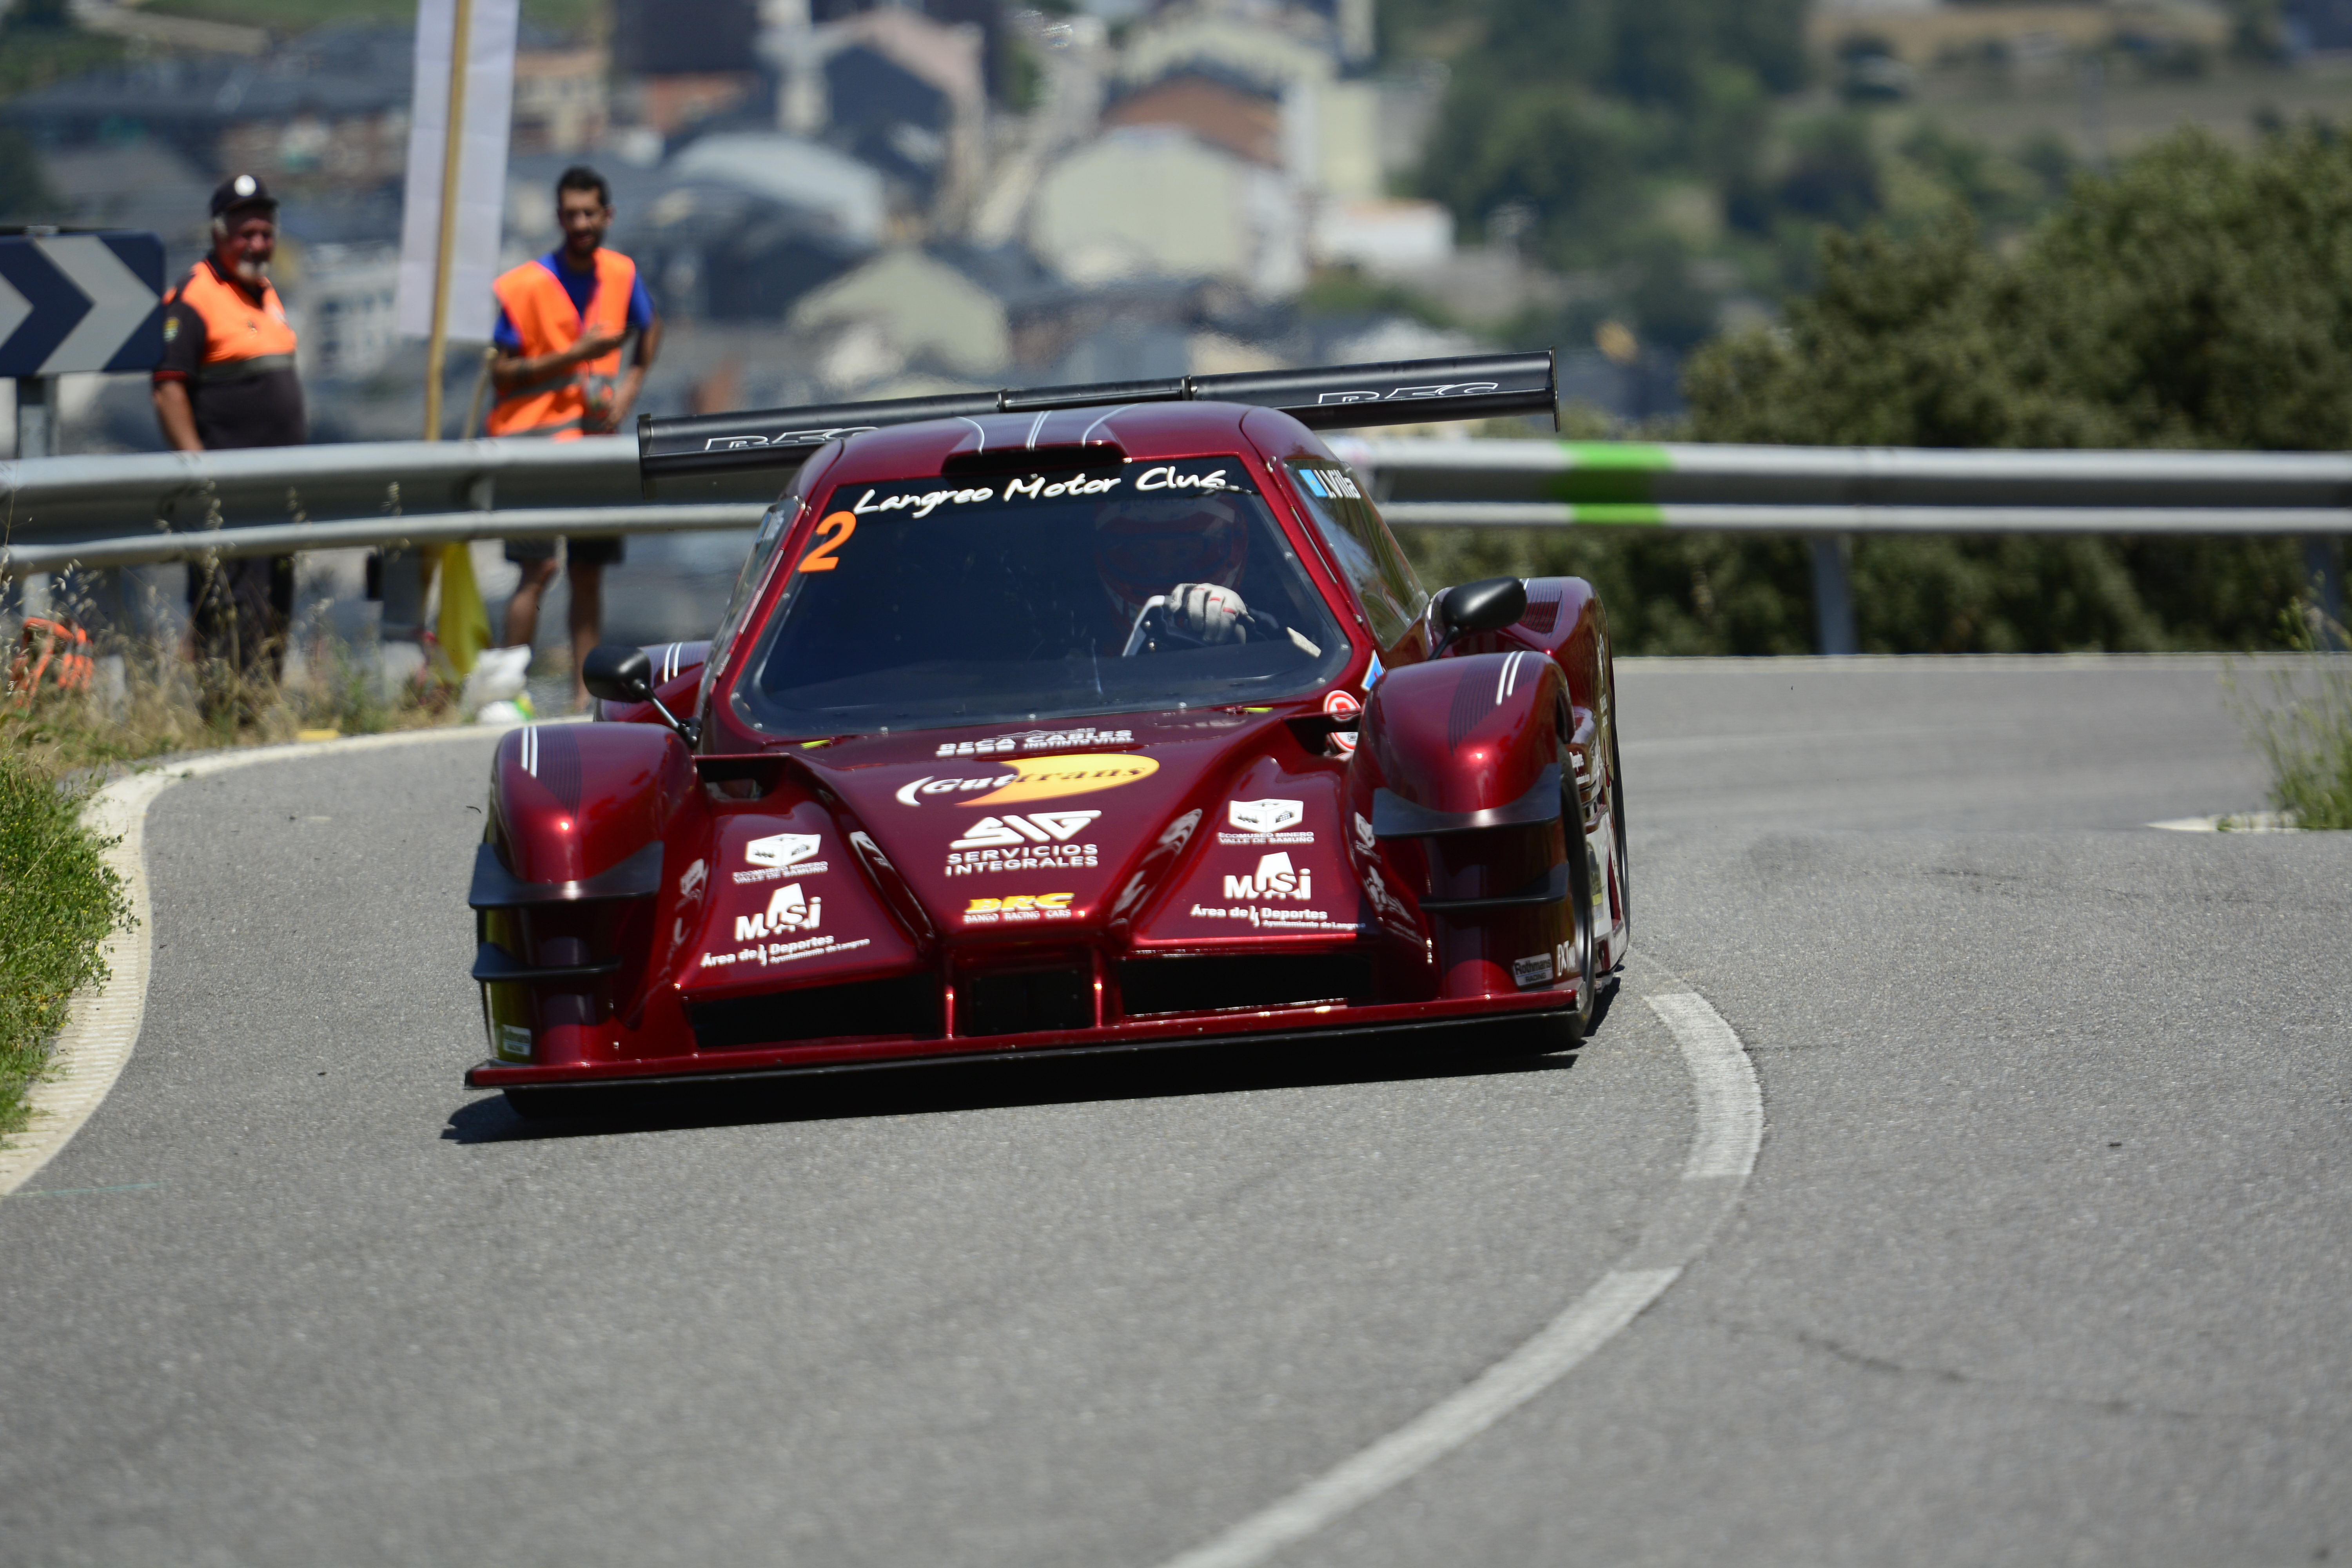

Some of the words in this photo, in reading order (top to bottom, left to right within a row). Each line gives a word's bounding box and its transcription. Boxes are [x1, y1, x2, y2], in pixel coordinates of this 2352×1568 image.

[853, 488, 994, 519] Langreo
[1003, 473, 1122, 502] Motor
[798, 511, 857, 573] 2
[1023, 739, 1090, 750] INSTINTO
[1025, 730, 1132, 743] CABLES
[946, 843, 1098, 865] SERVICIOS
[945, 855, 1099, 877] INTEGRALES
[964, 892, 1076, 915] BRC
[1190, 903, 1227, 917] Área
[1229, 906, 1249, 918] de
[1003, 911, 1040, 921] RACING
[1044, 909, 1072, 919] CARS
[1261, 907, 1328, 921] Deportes
[1261, 919, 1319, 930] Ayuntamiento
[769, 935, 835, 956] Deportes
[700, 952, 736, 968] Área
[738, 948, 758, 961] de
[1514, 958, 1552, 976] Rothmans
[1524, 972, 1547, 983] RACING
